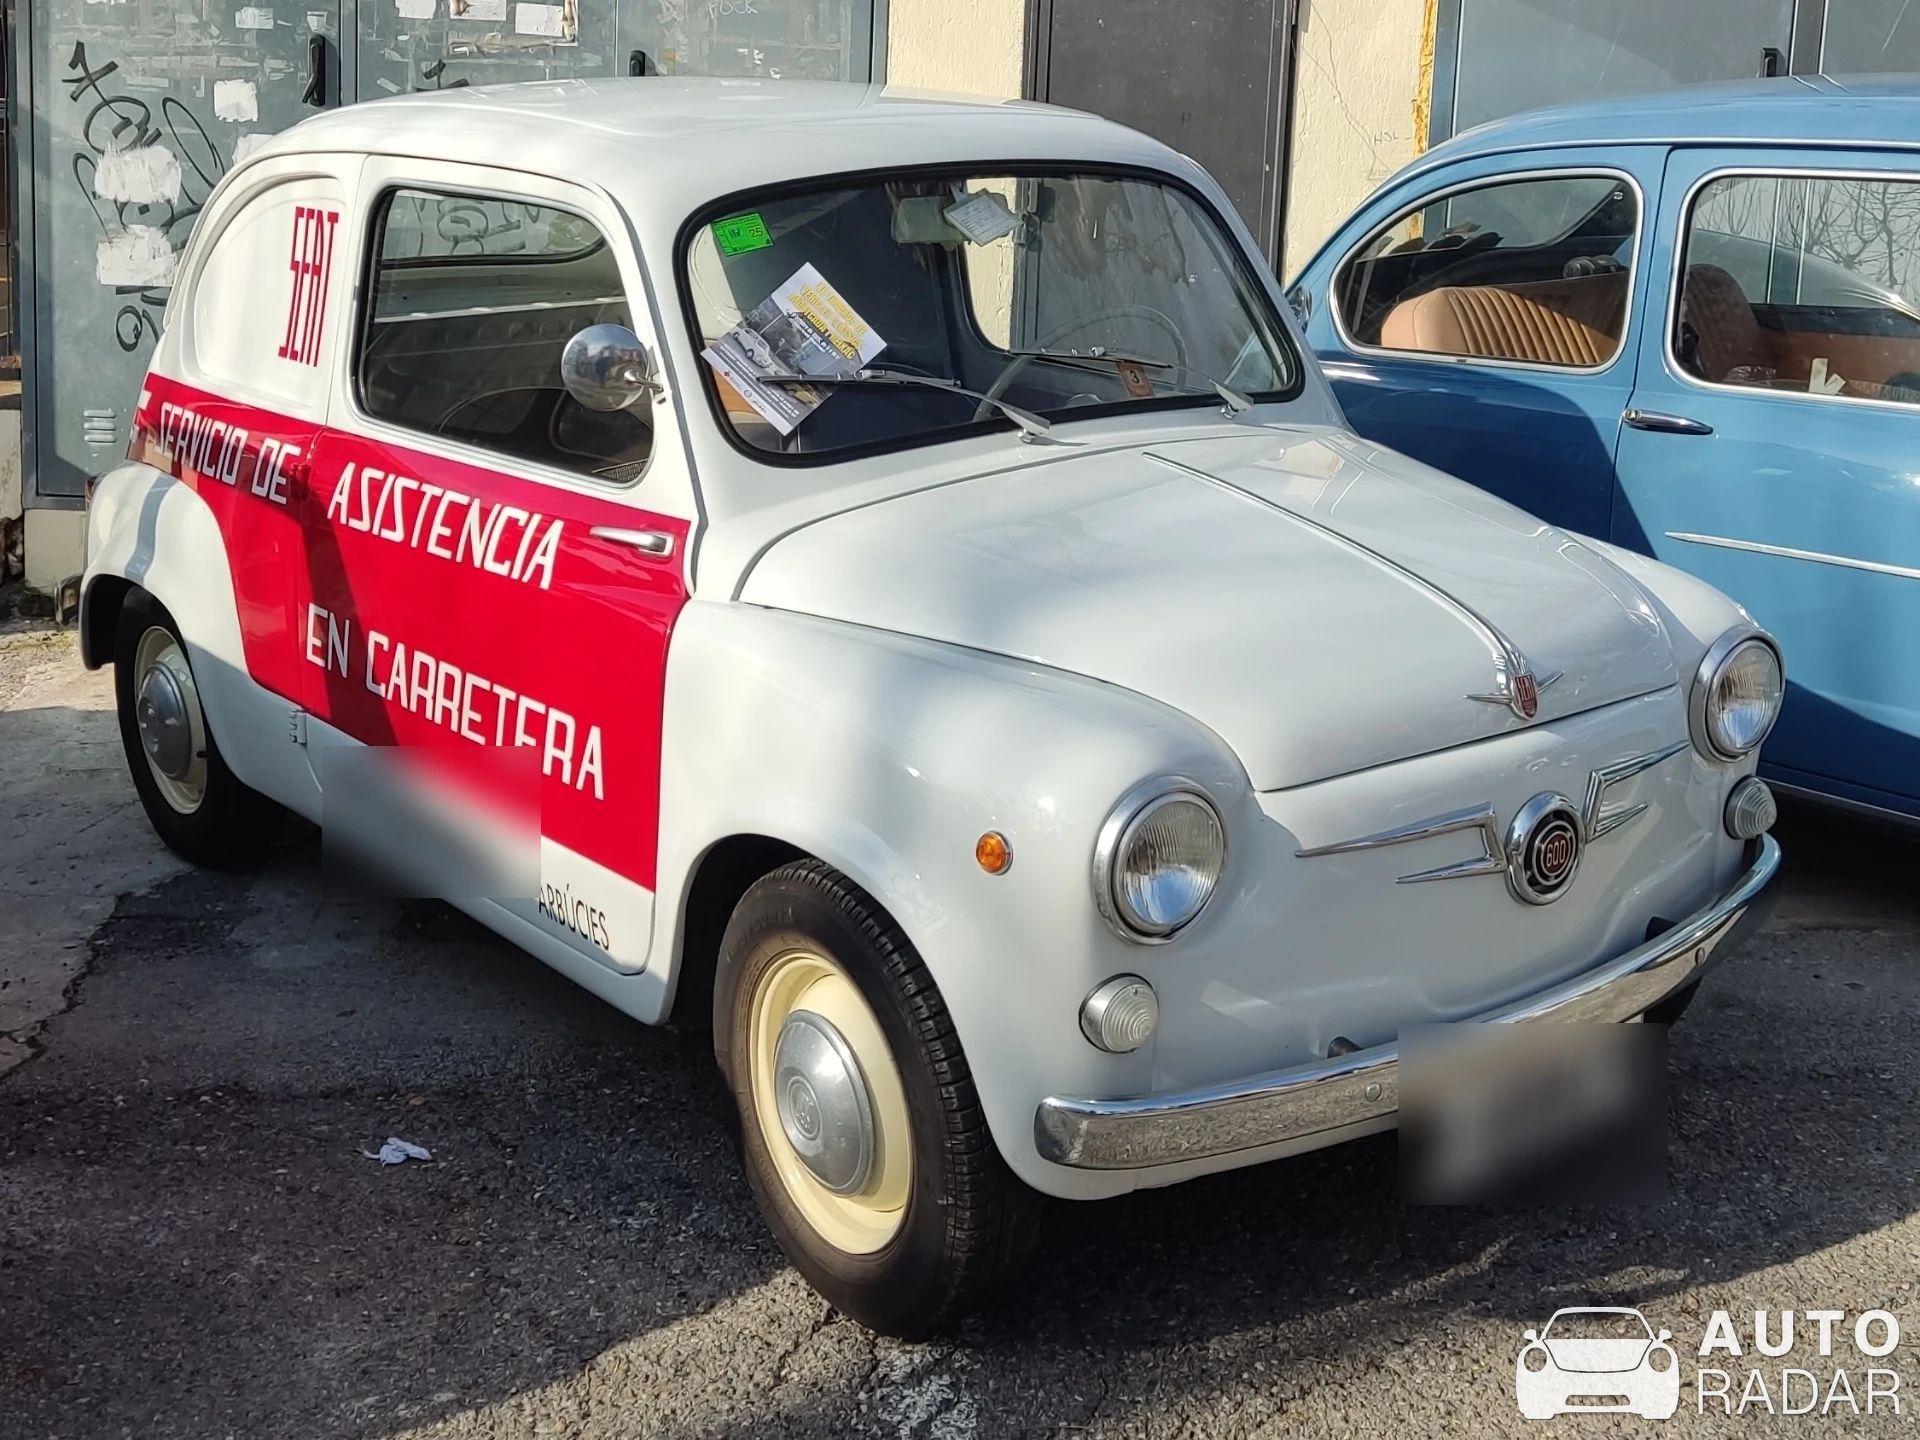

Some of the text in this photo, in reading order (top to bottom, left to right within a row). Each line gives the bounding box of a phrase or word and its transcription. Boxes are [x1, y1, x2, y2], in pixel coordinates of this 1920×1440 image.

[278, 206, 339, 367] SEAT
[154, 401, 249, 486] SERVICIO
[251, 437, 301, 505] DE
[327, 461, 565, 591] ASISTENCIA
[306, 602, 350, 679] EN
[1546, 840, 1567, 868] 600
[538, 883, 609, 951] ARBÚCIES
